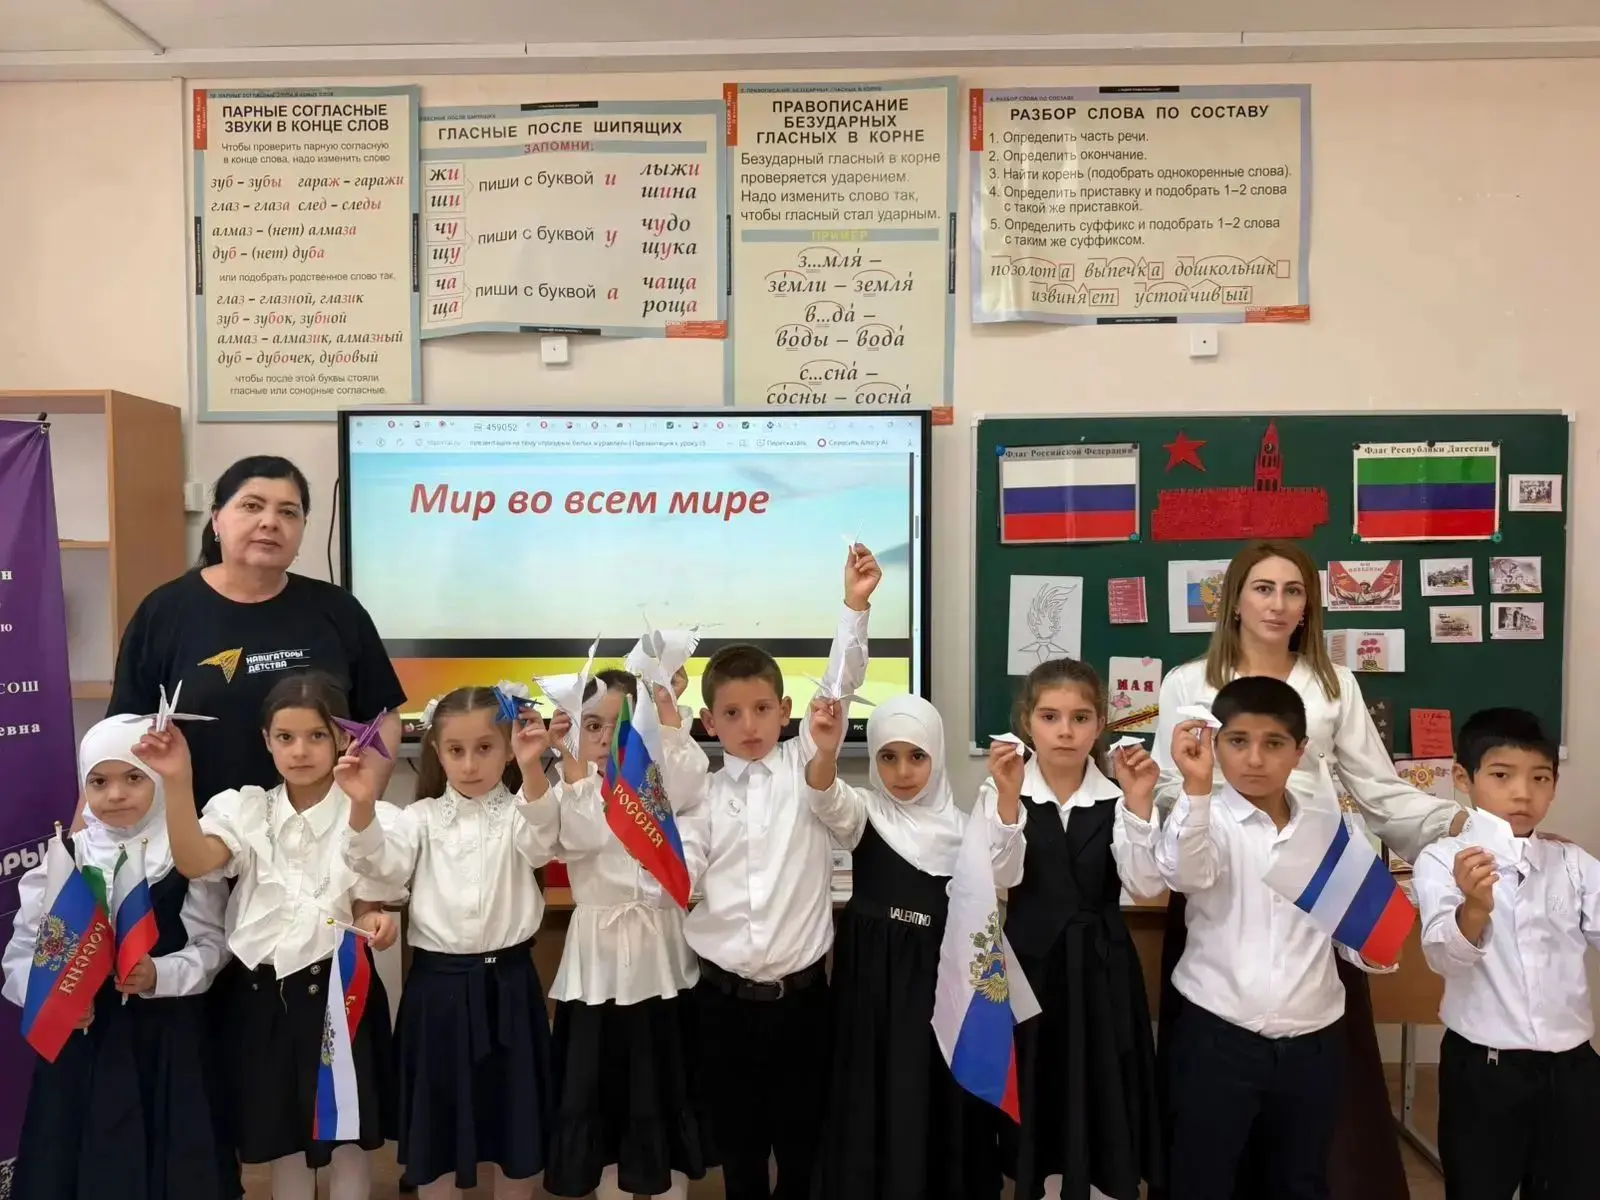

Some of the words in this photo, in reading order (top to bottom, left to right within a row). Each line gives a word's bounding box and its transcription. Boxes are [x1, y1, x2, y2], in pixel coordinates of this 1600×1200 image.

[222, 105, 287, 118] ПАРНЫЕ
[292, 104, 388, 117] СОГЛАСНЫЕ
[772, 98, 909, 113] ПРАВОПИСАНИЕ
[1010, 107, 1077, 122] РАЗБОР
[1087, 106, 1145, 120] СЛОВА
[1156, 106, 1180, 119] ПО
[1190, 105, 1269, 119] СОСТАВУ
[224, 120, 272, 133] ЗВУКИ
[277, 120, 287, 132] В
[291, 119, 342, 133] КОНЦЕ
[347, 118, 389, 131] СЛОВ
[784, 114, 897, 130] БЕЗУДАРНЫХ
[437, 125, 517, 141] ГЛАСНЫЕ
[527, 121, 583, 135] ПОСЛЕ
[593, 120, 683, 136] ШИПЯЩИХ
[756, 131, 837, 144] ГЛАСНЫХ
[848, 131, 858, 143] В
[869, 129, 925, 143] КОРНЕ
[1002, 131, 1077, 145] Определить
[1080, 132, 1115, 142] часть
[1117, 132, 1149, 144] речи.
[221, 142, 251, 152] Чтобы
[253, 142, 302, 153] проверить
[304, 143, 339, 153] парную
[341, 141, 389, 152] согласную
[231, 155, 258, 165] конце
[292, 155, 315, 165] надо
[317, 155, 361, 163] изменить
[363, 154, 391, 162] слово
[740, 152, 824, 167] Безударный
[828, 152, 885, 165] гласный
[901, 151, 941, 165] корне
[1002, 149, 1077, 163] Определить
[1080, 150, 1147, 161] окончание.
[430, 167, 459, 181] жи
[639, 162, 701, 177] лыжи
[1002, 167, 1039, 180] Найти
[1042, 168, 1084, 181] корень
[1087, 166, 1155, 181] (подобрать
[1156, 166, 1245, 180] однокоренные
[1247, 164, 1292, 178] слова).
[210, 174, 234, 191] зуб
[247, 174, 282, 191] зубы
[297, 176, 341, 191] гараж
[354, 175, 404, 190] гаражи
[479, 177, 519, 193] пиши
[536, 170, 595, 187] буквой
[740, 172, 827, 185] проверяется
[831, 171, 910, 185] ударением.
[640, 185, 697, 199] шина
[740, 190, 777, 203] Надо
[781, 191, 845, 202] изменить
[848, 191, 890, 201] слово
[894, 190, 919, 203] так,
[1003, 184, 1077, 199] Определить
[1079, 185, 1141, 200] приставку
[1155, 184, 1220, 199] подобрать
[1250, 184, 1288, 196] слова
[211, 201, 240, 212] глаз
[254, 201, 290, 212] глаза
[298, 197, 327, 212] след
[342, 197, 382, 211] следы
[431, 194, 461, 208] ши
[1013, 200, 1046, 214] такой
[1048, 203, 1066, 213] же
[1069, 200, 1143, 215] приставкой.
[740, 208, 782, 222] чтобы
[785, 208, 840, 222] гласный
[844, 210, 873, 220] стал
[877, 208, 941, 222] ударным.
[212, 225, 254, 237] алмаз
[267, 223, 305, 238] (нет)
[308, 224, 357, 237] алмаза
[434, 221, 458, 241] чу
[641, 213, 691, 236] чудо
[1004, 217, 1077, 233] Определить
[1079, 218, 1135, 234] суффикс
[1148, 217, 1214, 231] подобрать
[1243, 217, 1281, 229] слова
[478, 229, 517, 245] пиши
[536, 226, 595, 243] буквой
[811, 229, 869, 242] ПРИМЕР
[1013, 234, 1047, 247] таким
[1049, 236, 1067, 246] же
[1069, 234, 1146, 248] суффиксом.
[212, 246, 237, 263] дуб
[251, 246, 289, 260] (нет)
[292, 245, 325, 263] дуба
[432, 246, 461, 265] щу
[640, 240, 698, 261] щука
[990, 261, 1074, 279] позолота
[1084, 261, 1163, 279] выпечка
[1174, 259, 1275, 277] дошкольник
[219, 274, 237, 282] или
[239, 273, 288, 283] подобрать
[289, 272, 348, 283] родственное
[350, 272, 378, 281] слово
[436, 276, 457, 291] ча
[642, 276, 698, 294] чаща
[216, 295, 245, 305] глаз
[259, 293, 316, 306] глазной,
[320, 293, 364, 305] глазик
[474, 284, 518, 298] пиши
[537, 283, 597, 301] буквой
[1031, 288, 1119, 306] извиняет
[1134, 284, 1252, 309] устойчивый
[432, 301, 459, 316] ща
[642, 299, 698, 318] роща
[216, 312, 239, 328] зуб
[253, 312, 296, 328] зубок,
[299, 311, 347, 328] зубной
[217, 333, 258, 344] алмаз
[272, 332, 332, 345] алмазик,
[336, 330, 404, 344] алмазный
[217, 350, 242, 368] дуб
[256, 350, 315, 367] дубочек,
[319, 350, 379, 367] дубовый
[235, 373, 264, 383] чтобы
[265, 374, 293, 383] после
[295, 373, 316, 383] этой
[318, 373, 346, 384] буквы
[347, 373, 379, 382] стояли
[230, 387, 268, 396] гласные
[270, 387, 288, 395] или
[289, 386, 334, 396] сонорные
[485, 423, 518, 432] 459052
[1364, 447, 1388, 455] Флаг
[1391, 446, 1445, 455] Республики
[1447, 445, 1490, 454] Дагестан
[410, 483, 496, 521] Мир
[507, 490, 553, 514] во
[564, 490, 657, 514] всем
[668, 490, 770, 521] мире
[245, 650, 304, 664] НАВИГАТОРЫ
[248, 660, 287, 673] ДЕТСТВА
[1116, 678, 1154, 693] МАЯ
[603, 784, 664, 848] РОССИЯ
[890, 906, 932, 927] VALENTINO
